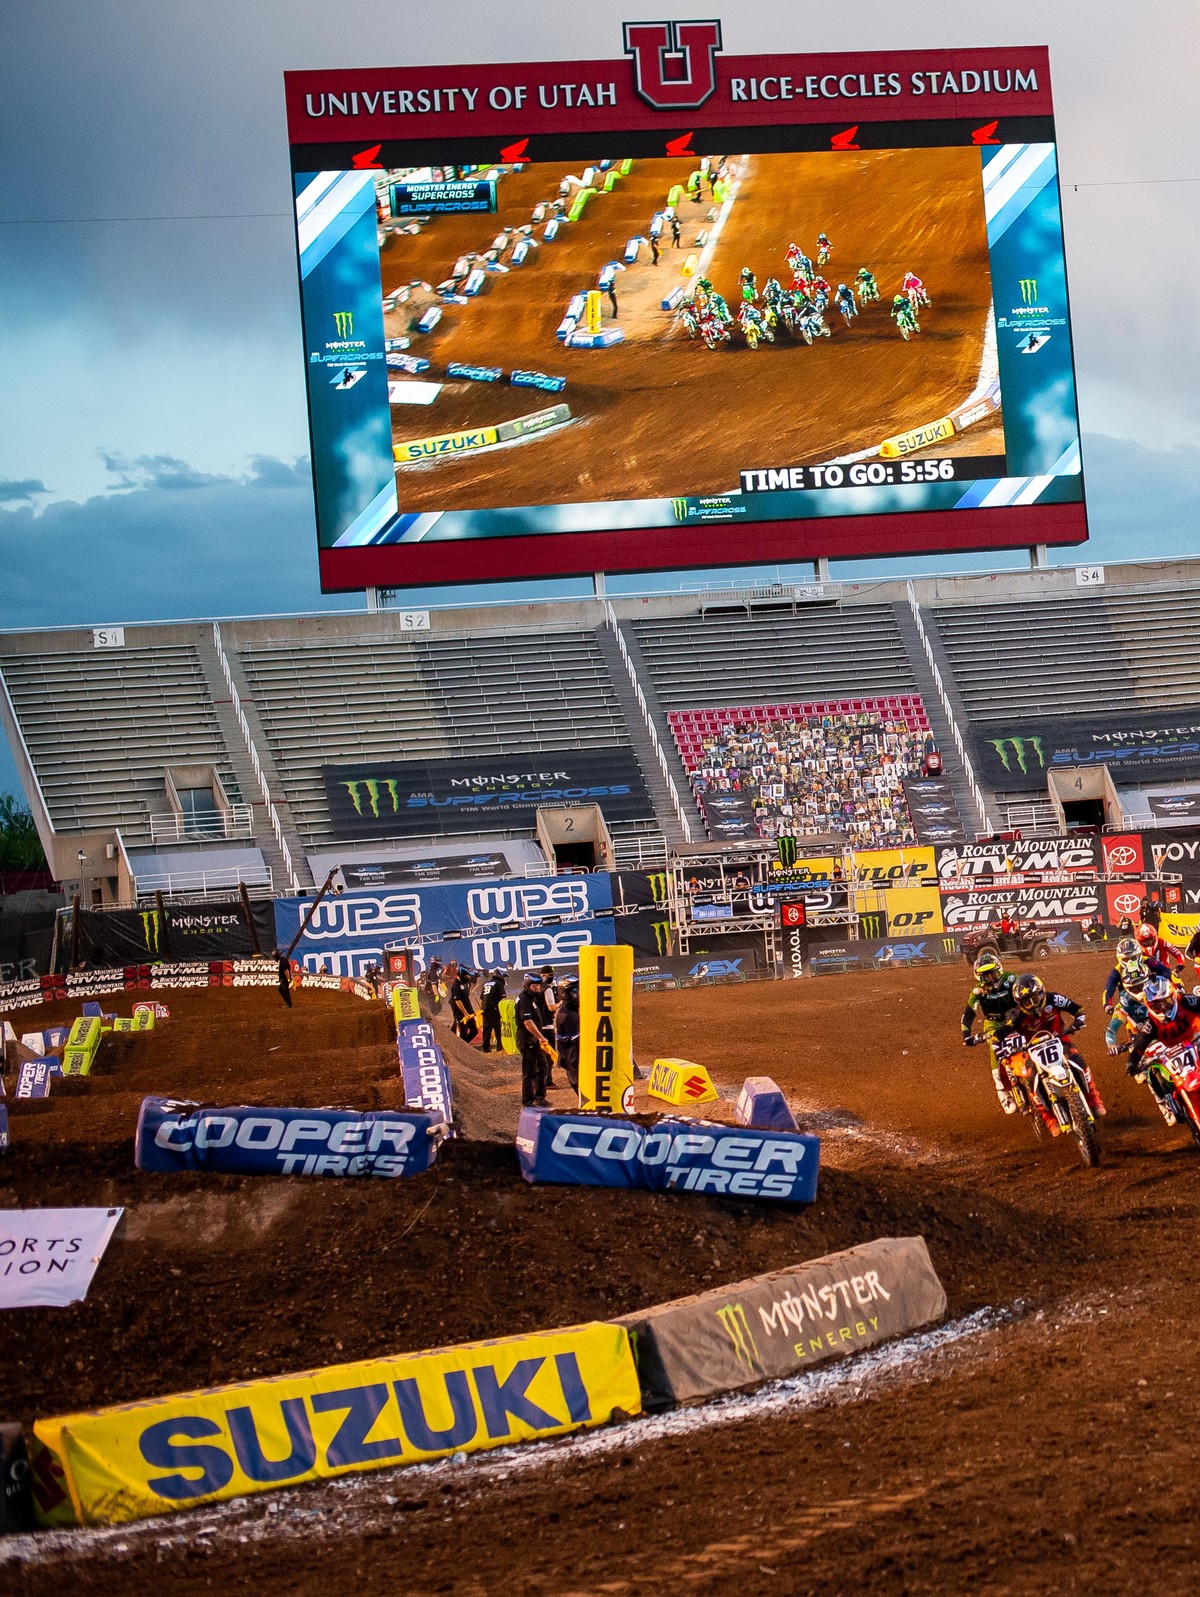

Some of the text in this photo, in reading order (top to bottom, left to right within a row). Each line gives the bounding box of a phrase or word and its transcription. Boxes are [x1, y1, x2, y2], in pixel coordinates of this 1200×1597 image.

[730, 68, 1039, 102] RICE-ECCLES STADIUM
[305, 83, 618, 118] UNIVERSITY OF UTAH
[406, 182, 479, 193] MONSTER ENERGY
[411, 190, 475, 201] SUPERCROSS
[400, 200, 490, 214] SUPERCROSS
[998, 319, 1066, 328] SUPERCROSS
[310, 352, 384, 363] SUPERCROSS
[408, 432, 486, 458] SUZUKI
[897, 424, 949, 453] SUZUKI
[740, 460, 954, 491] TIME TO GO: 5:56
[1112, 735, 1192, 747] ENERGY
[1122, 758, 1151, 767] World
[409, 791, 435, 800] AMA
[471, 781, 555, 793] ENERGY
[1073, 776, 1084, 791] 4
[405, 784, 632, 809] SUPERCROSS
[482, 803, 509, 812] World
[564, 816, 576, 832] 2
[961, 838, 1093, 858] ROCKY MOUNTAIN
[752, 880, 831, 893] SUPERCROSS
[966, 885, 1098, 906] ROCKY MOUNTAIN
[466, 880, 590, 925] WPS
[299, 893, 422, 940] WPS
[892, 926, 925, 936] TIRES
[789, 928, 803, 979] TOYOTA
[1037, 1044, 1060, 1067] 16
[1171, 1052, 1197, 1076] 94
[651, 1063, 679, 1098] SUZUKI
[153, 1115, 416, 1155] COOPER
[551, 1122, 806, 1174] COOPER
[276, 1152, 408, 1178] TIRES
[664, 1166, 798, 1199] TIRES
[760, 1269, 891, 1343] MONSTER
[795, 1314, 881, 1358] ENERGY
[139, 1352, 594, 1502] SUZUKI
